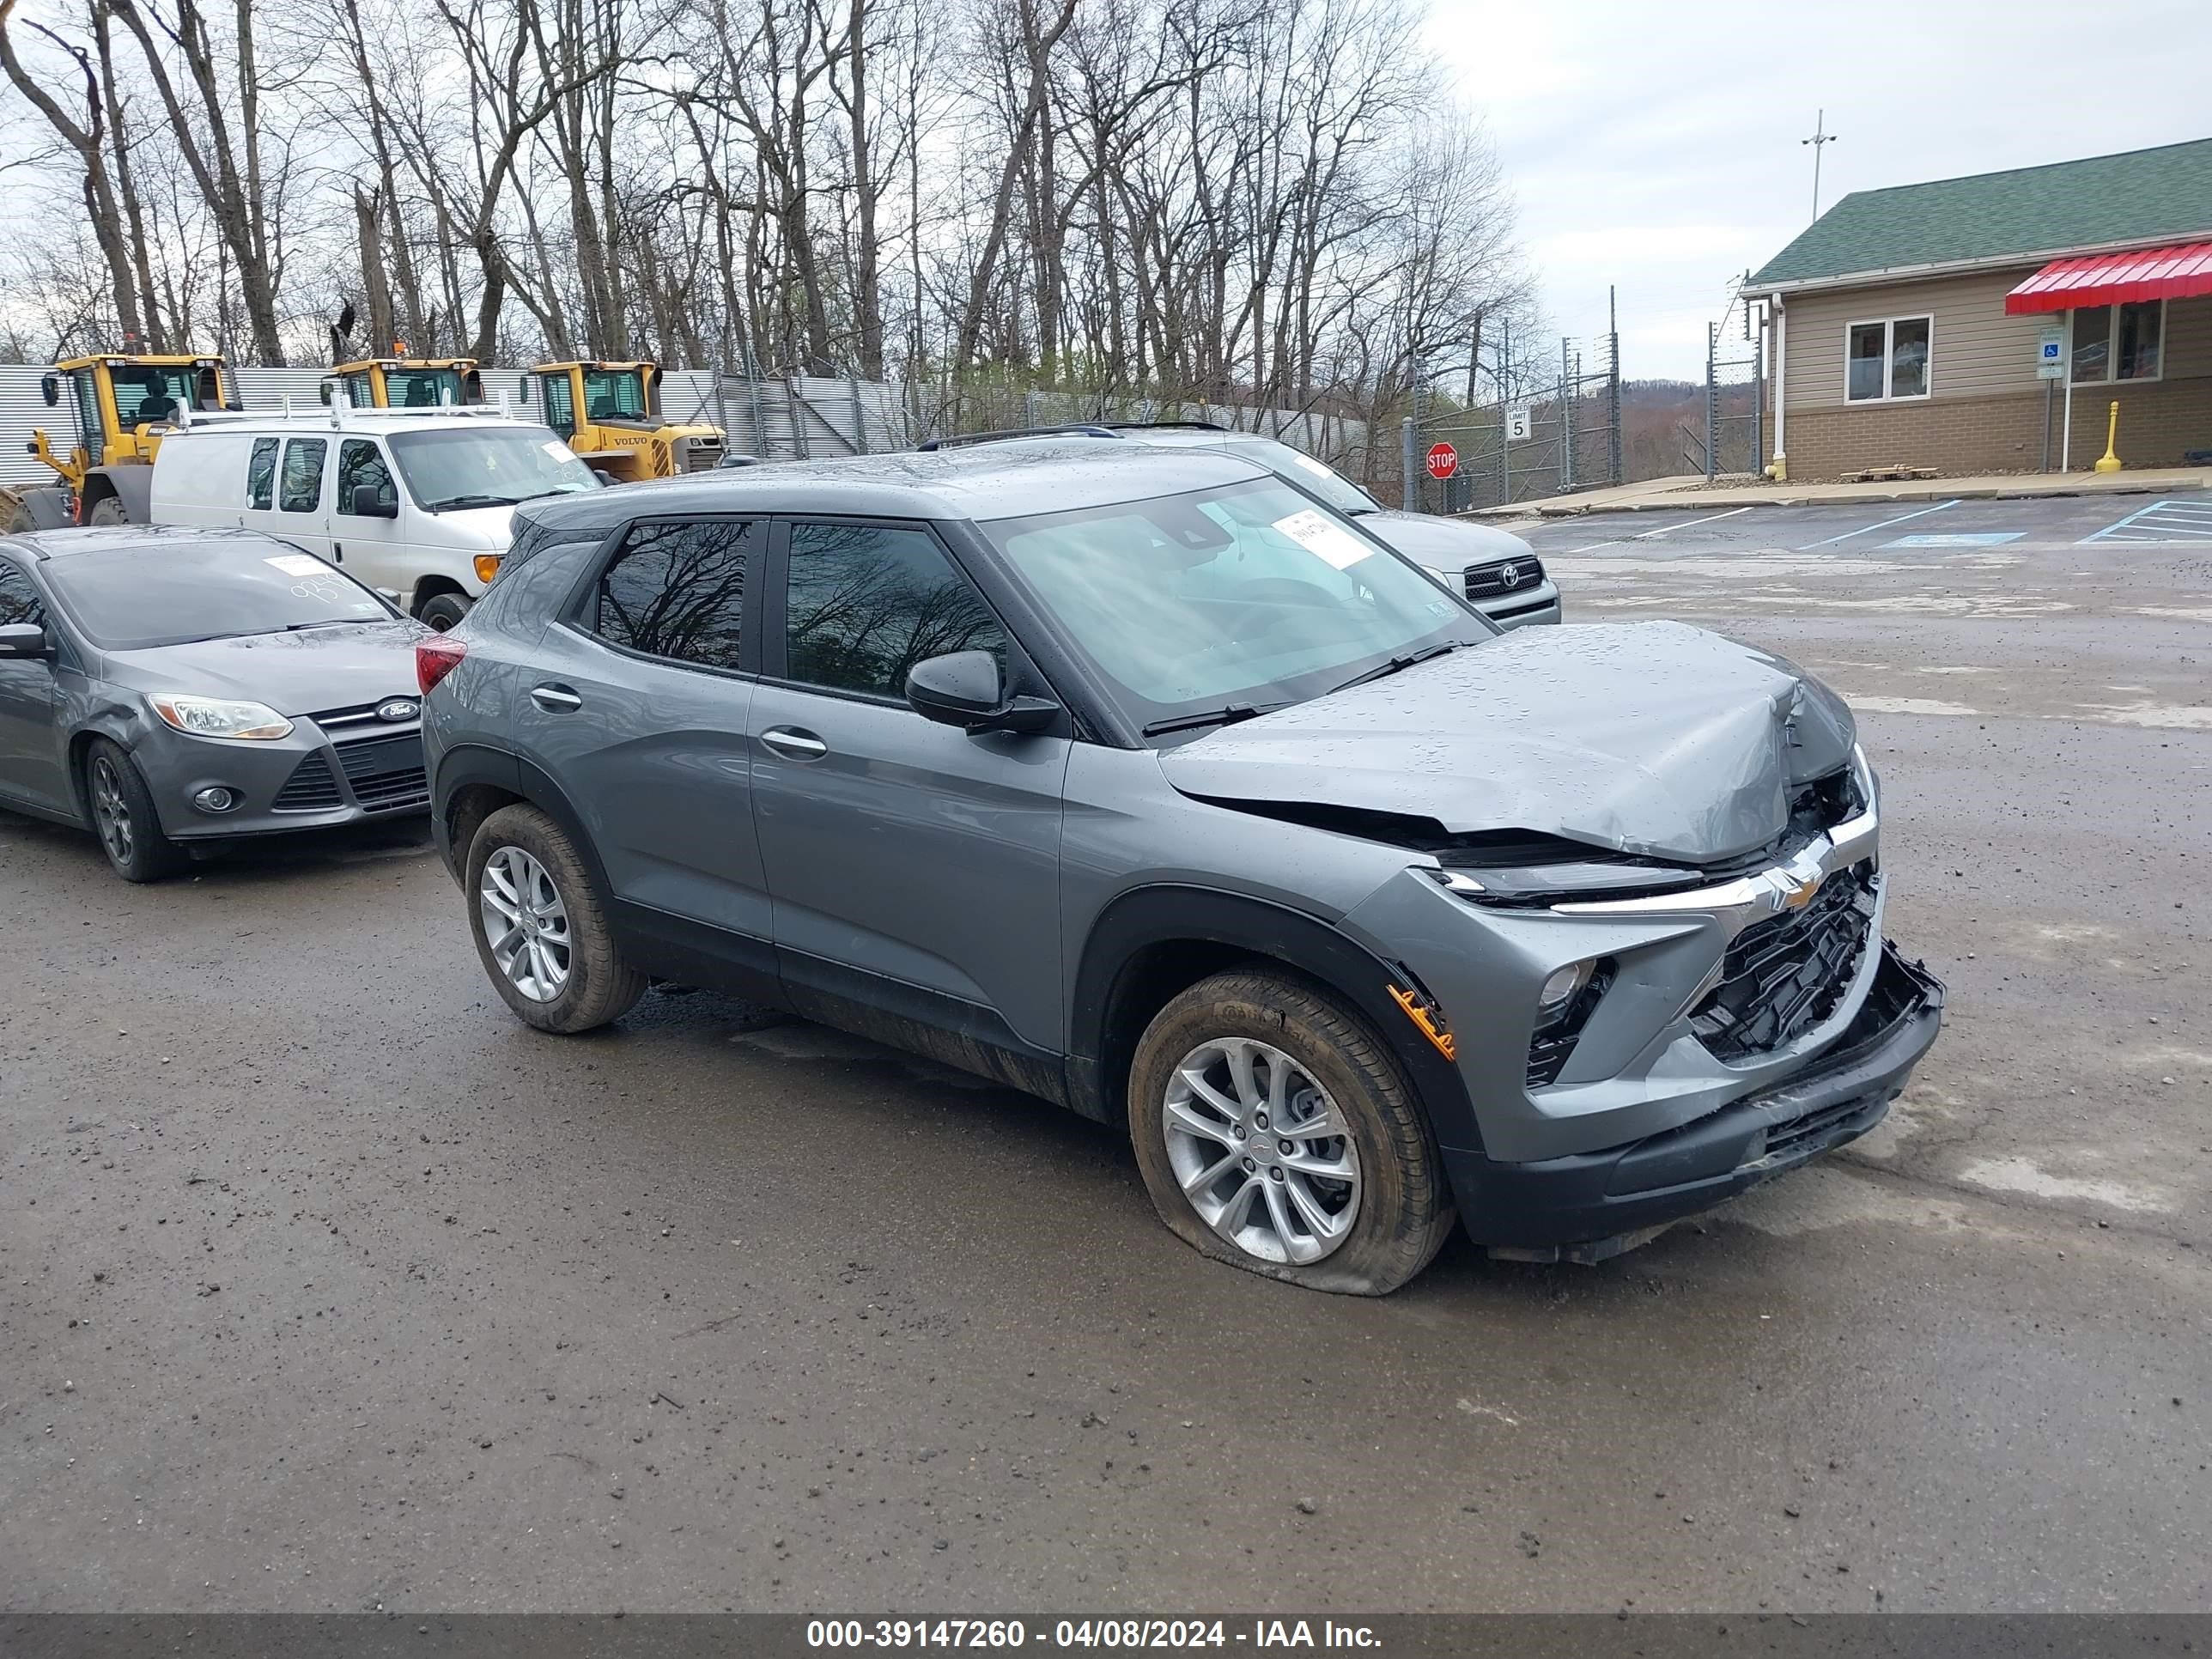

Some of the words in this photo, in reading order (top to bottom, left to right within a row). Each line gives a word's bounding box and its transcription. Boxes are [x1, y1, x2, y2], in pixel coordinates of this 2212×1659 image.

[1514, 421, 1523, 435] 5
[614, 437, 647, 446] VOLVO
[1428, 453, 1455, 469] STOP
[389, 704, 410, 715] Ford
